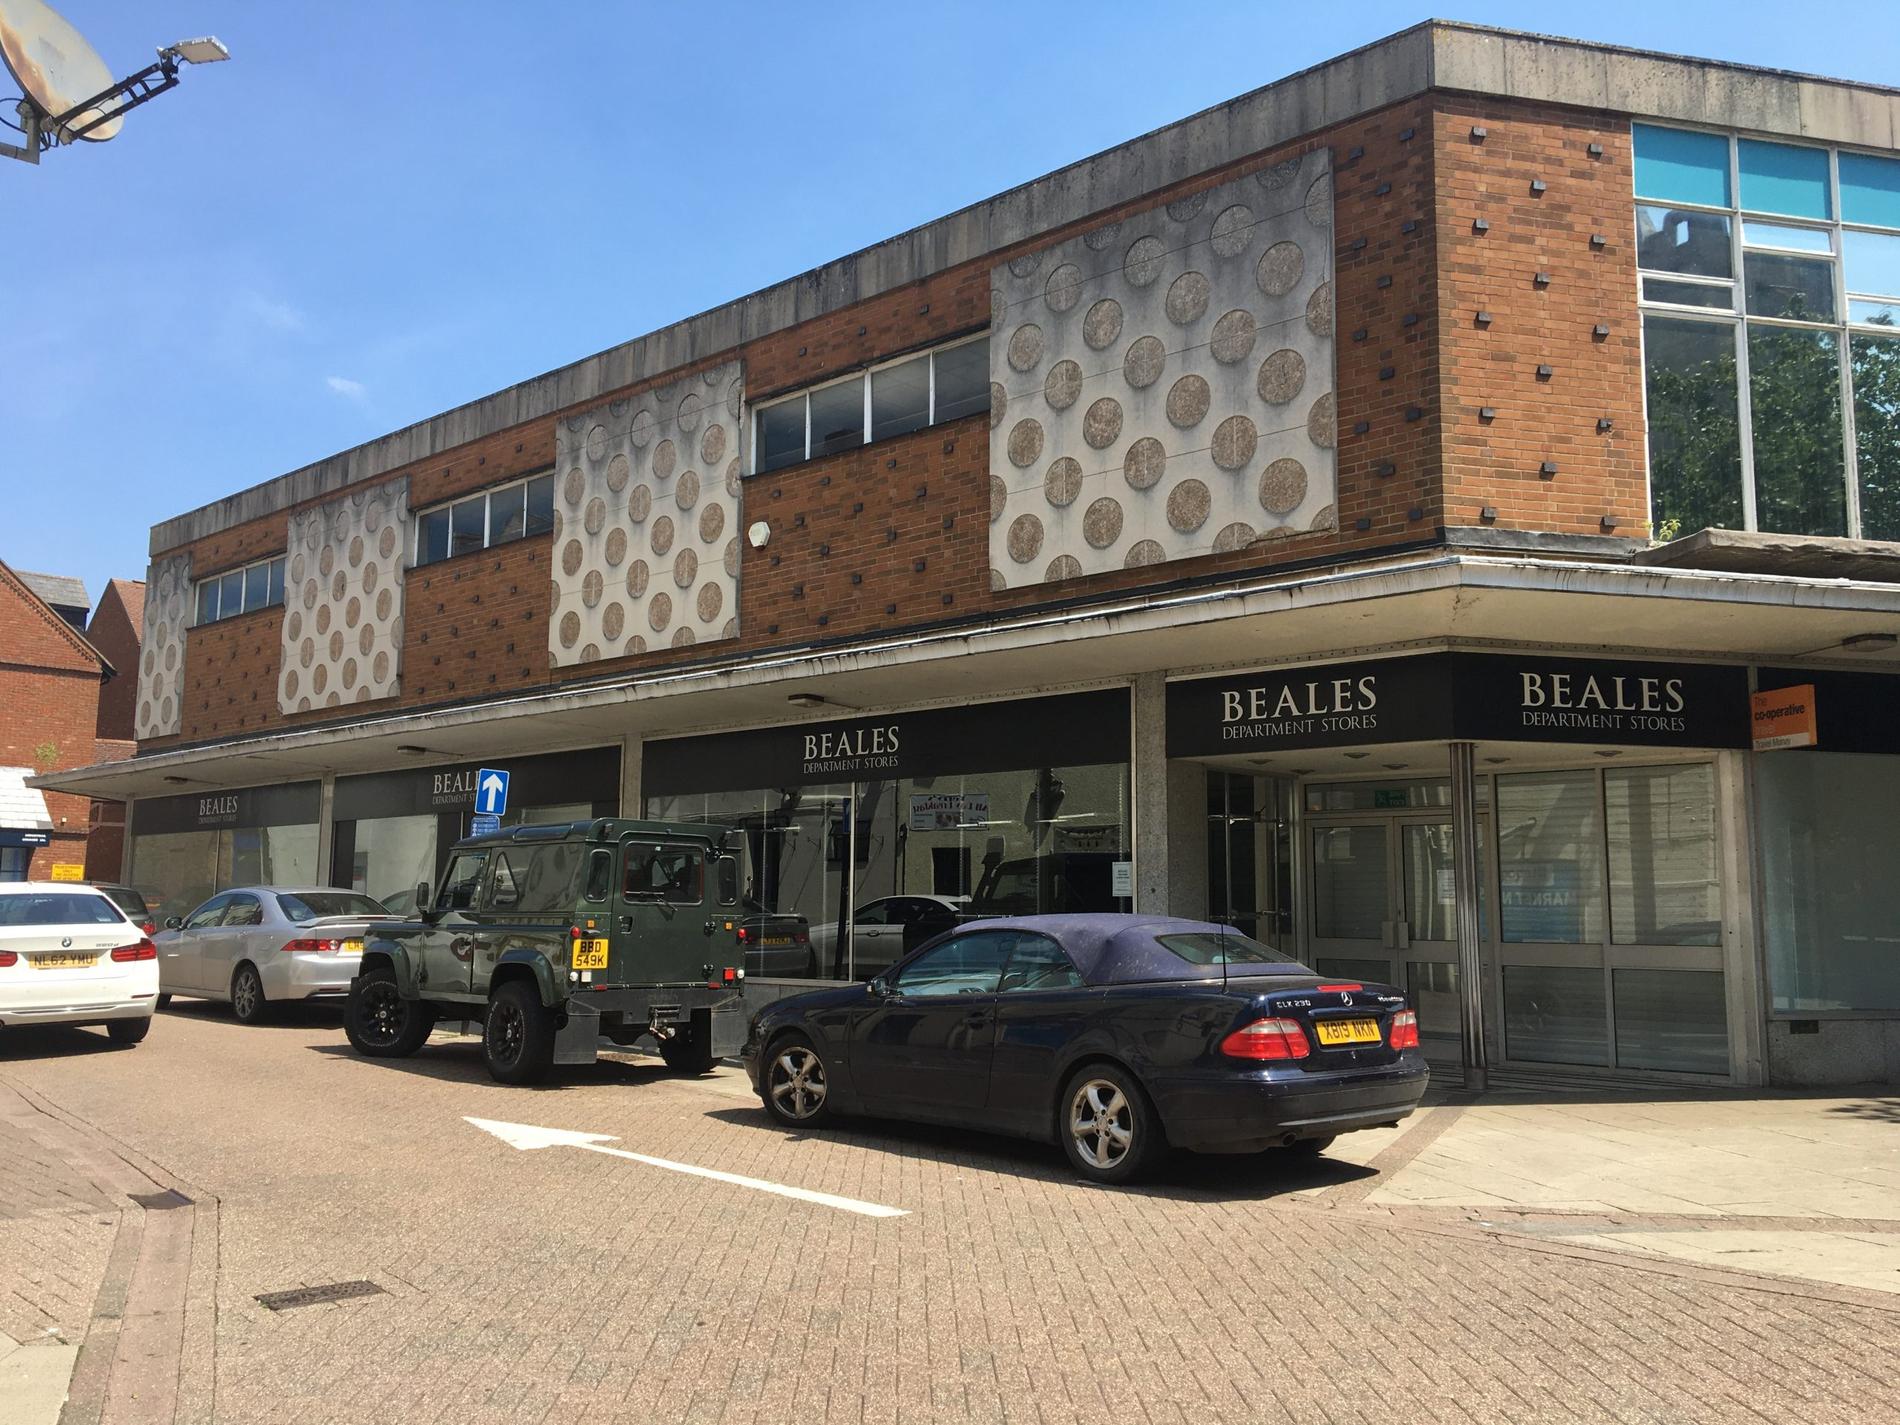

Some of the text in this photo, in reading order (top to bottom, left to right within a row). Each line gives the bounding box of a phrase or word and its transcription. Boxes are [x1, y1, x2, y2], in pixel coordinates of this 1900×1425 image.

[1221, 676, 1377, 723] BEALES
[1520, 672, 1684, 713] BEALES
[1522, 711, 1686, 732] DEPARTMENT STORES
[1754, 703, 1806, 721] co-operative
[1222, 714, 1378, 740] DEPARTMENT STORES
[803, 726, 900, 760] BEALES
[803, 755, 899, 774] DEPARTMENT STORES
[433, 770, 480, 794] BEAL
[199, 795, 238, 816] BEALES
[34, 953, 93, 967] NL62 YMU
[576, 954, 604, 967] 549K
[1322, 1019, 1376, 1040] X819 NKN
